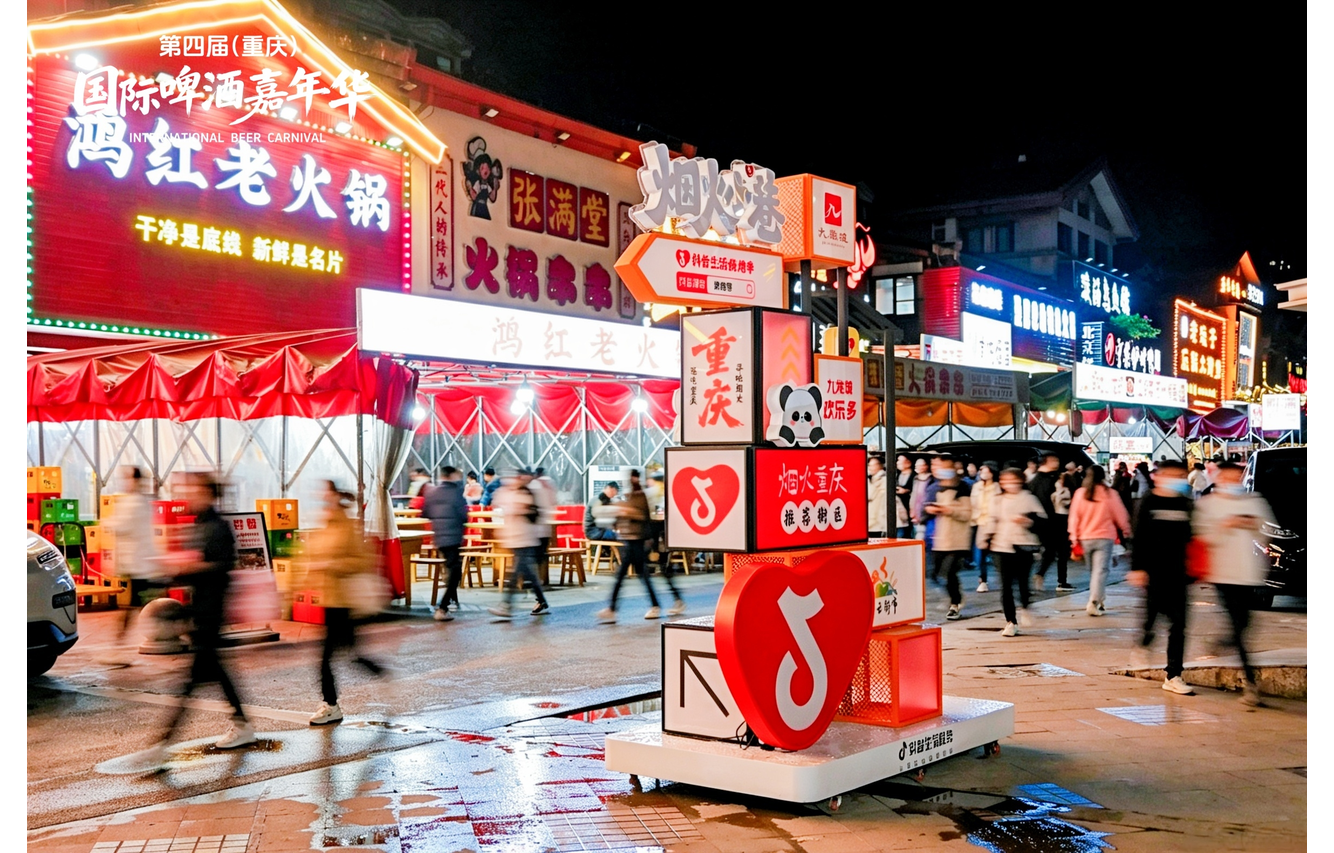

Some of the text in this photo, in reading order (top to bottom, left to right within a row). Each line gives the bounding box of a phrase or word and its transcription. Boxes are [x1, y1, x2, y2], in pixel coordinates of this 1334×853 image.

[66, 111, 391, 233] 鸿红老火锅
[513, 177, 607, 242] 张满堂
[134, 215, 344, 275] 干净是底线 新鲜是名片
[465, 237, 613, 312] 火锅串串
[491, 316, 680, 370] 鸿红老火
[691, 326, 745, 429] 重庆
[823, 400, 857, 421] 欢乐多
[778, 462, 848, 498] 烟火重庆
